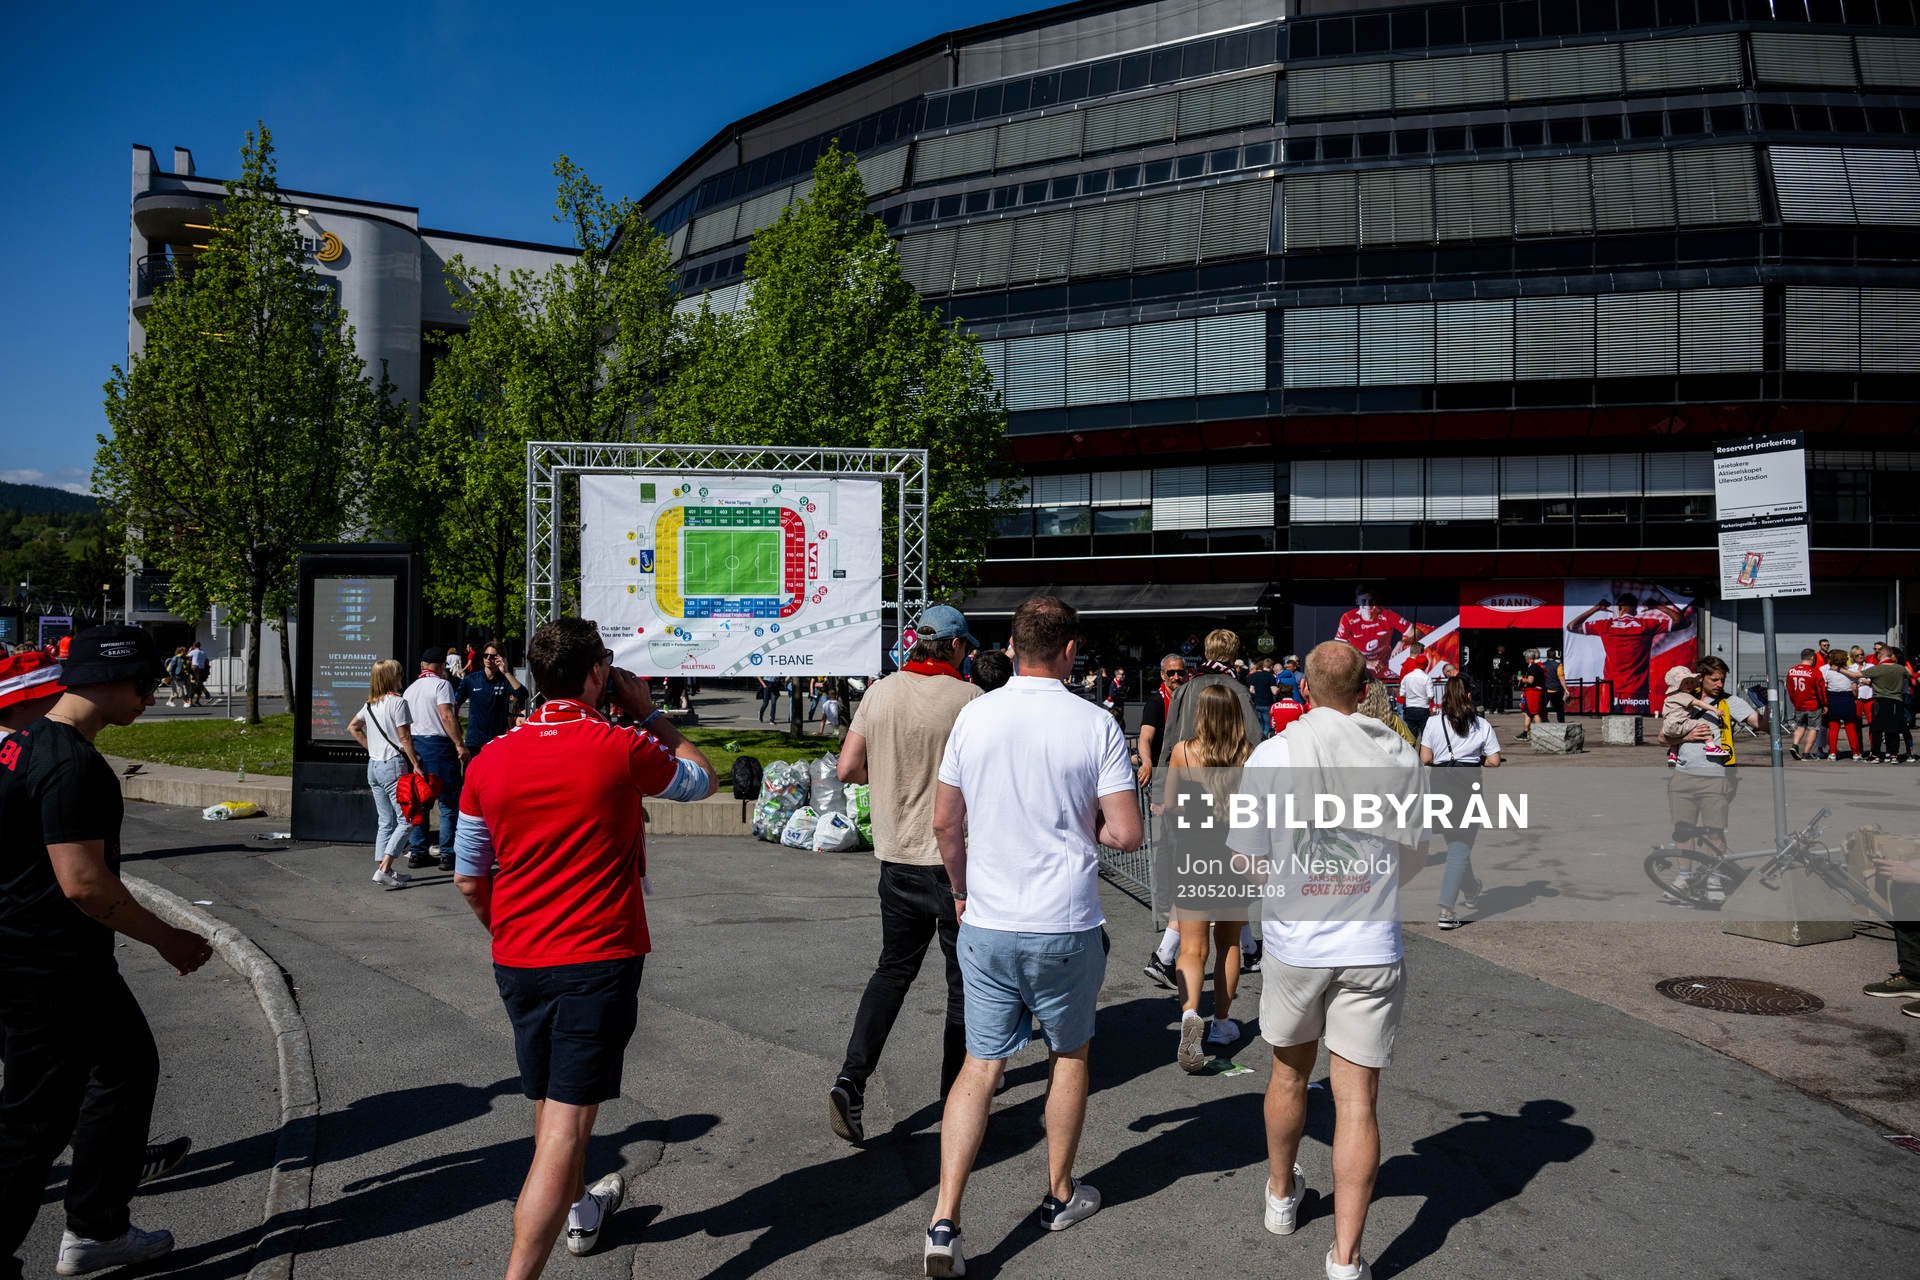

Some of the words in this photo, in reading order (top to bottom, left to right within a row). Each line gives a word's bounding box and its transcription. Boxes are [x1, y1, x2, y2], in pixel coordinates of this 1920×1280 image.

[1716, 443, 1754, 454] Reservert
[1755, 438, 1797, 450] parkering
[1717, 461, 1749, 470] Leietakere
[1718, 466, 1762, 477] Aktieselskapet
[1743, 474, 1768, 482] Stadion
[809, 545, 817, 577] VG
[1490, 598, 1532, 607] BRANN
[1611, 620, 1642, 628] BA
[768, 654, 814, 665] T-BANE
[1793, 677, 1806, 692] 16
[1619, 697, 1650, 706] unisport
[1301, 883, 1331, 896] GONE
